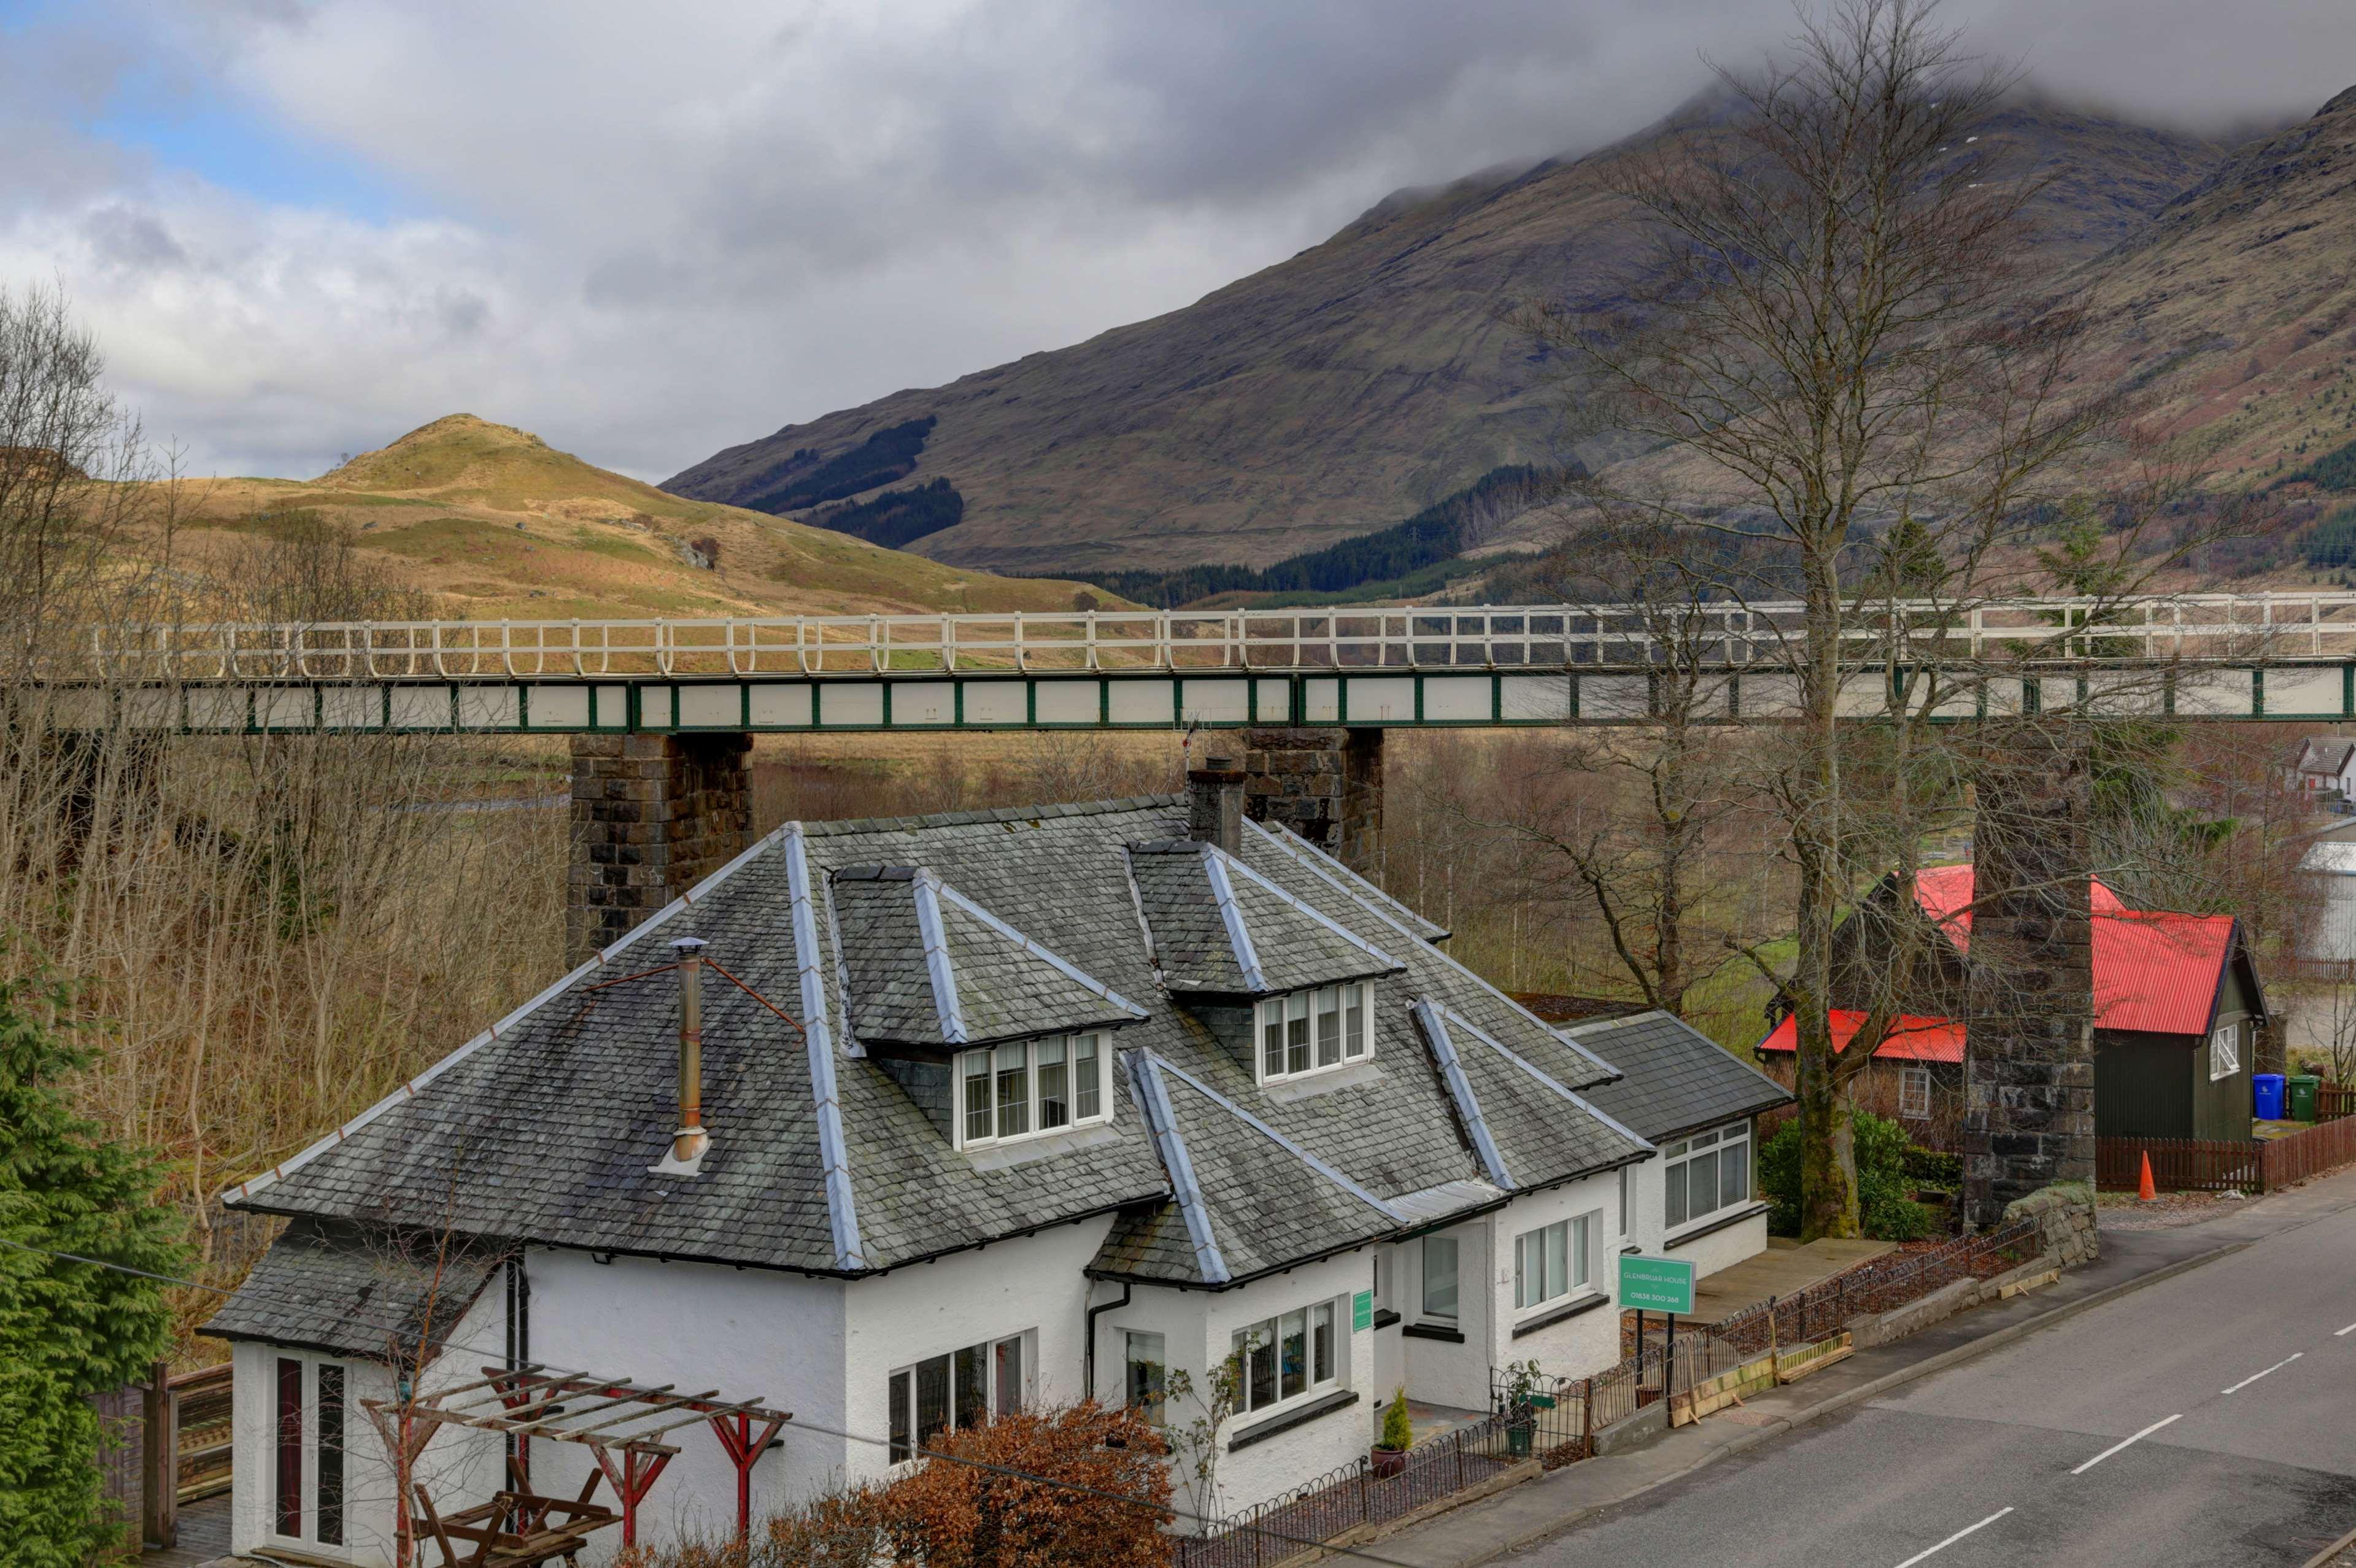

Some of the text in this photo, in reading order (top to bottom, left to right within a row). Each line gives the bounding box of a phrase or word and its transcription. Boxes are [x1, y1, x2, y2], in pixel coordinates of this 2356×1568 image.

[1623, 1272, 1687, 1285] GLENBRUAR HOUSE
[1630, 1292, 1650, 1300] 01838
